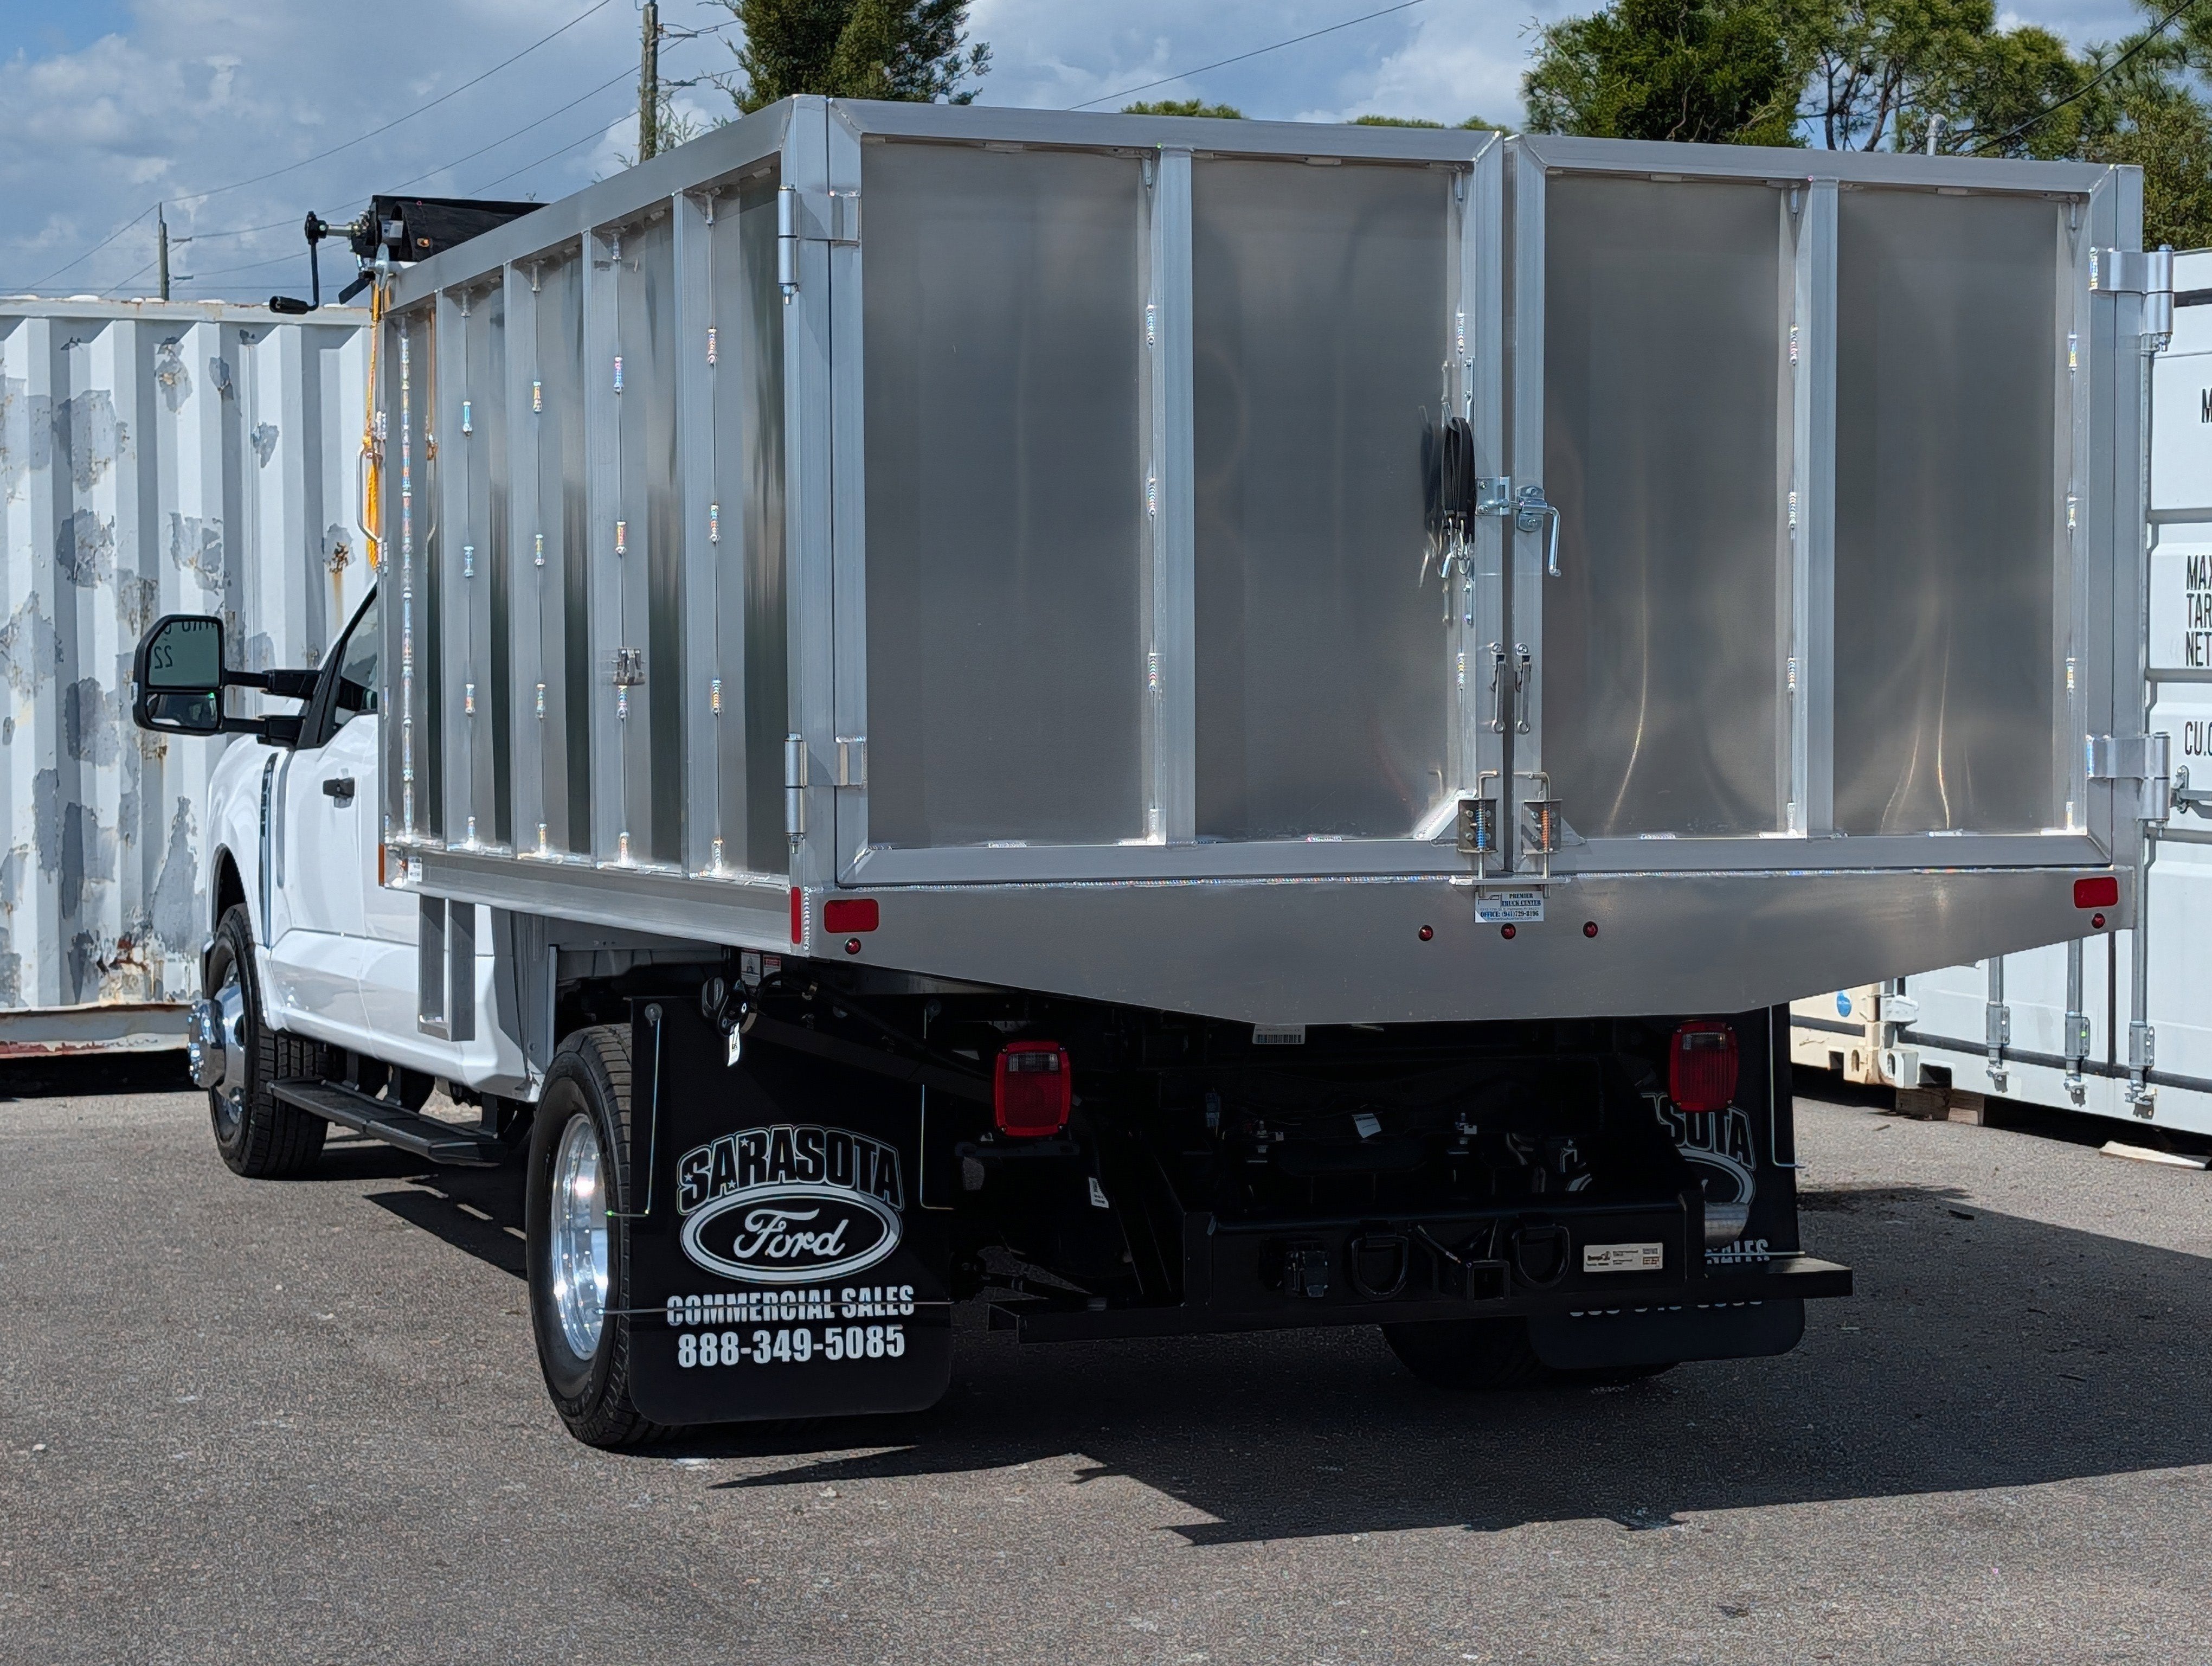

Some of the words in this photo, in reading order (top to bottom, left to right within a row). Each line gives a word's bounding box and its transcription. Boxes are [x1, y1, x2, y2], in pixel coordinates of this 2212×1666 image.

[2186, 631, 2212, 667] NET
[676, 1124, 904, 1215] SARASOTA
[733, 1208, 849, 1259] Ford
[667, 1289, 836, 1326] COMMERCIAL
[842, 1285, 915, 1318] SALES
[678, 1325, 905, 1368] 888-349-5085
